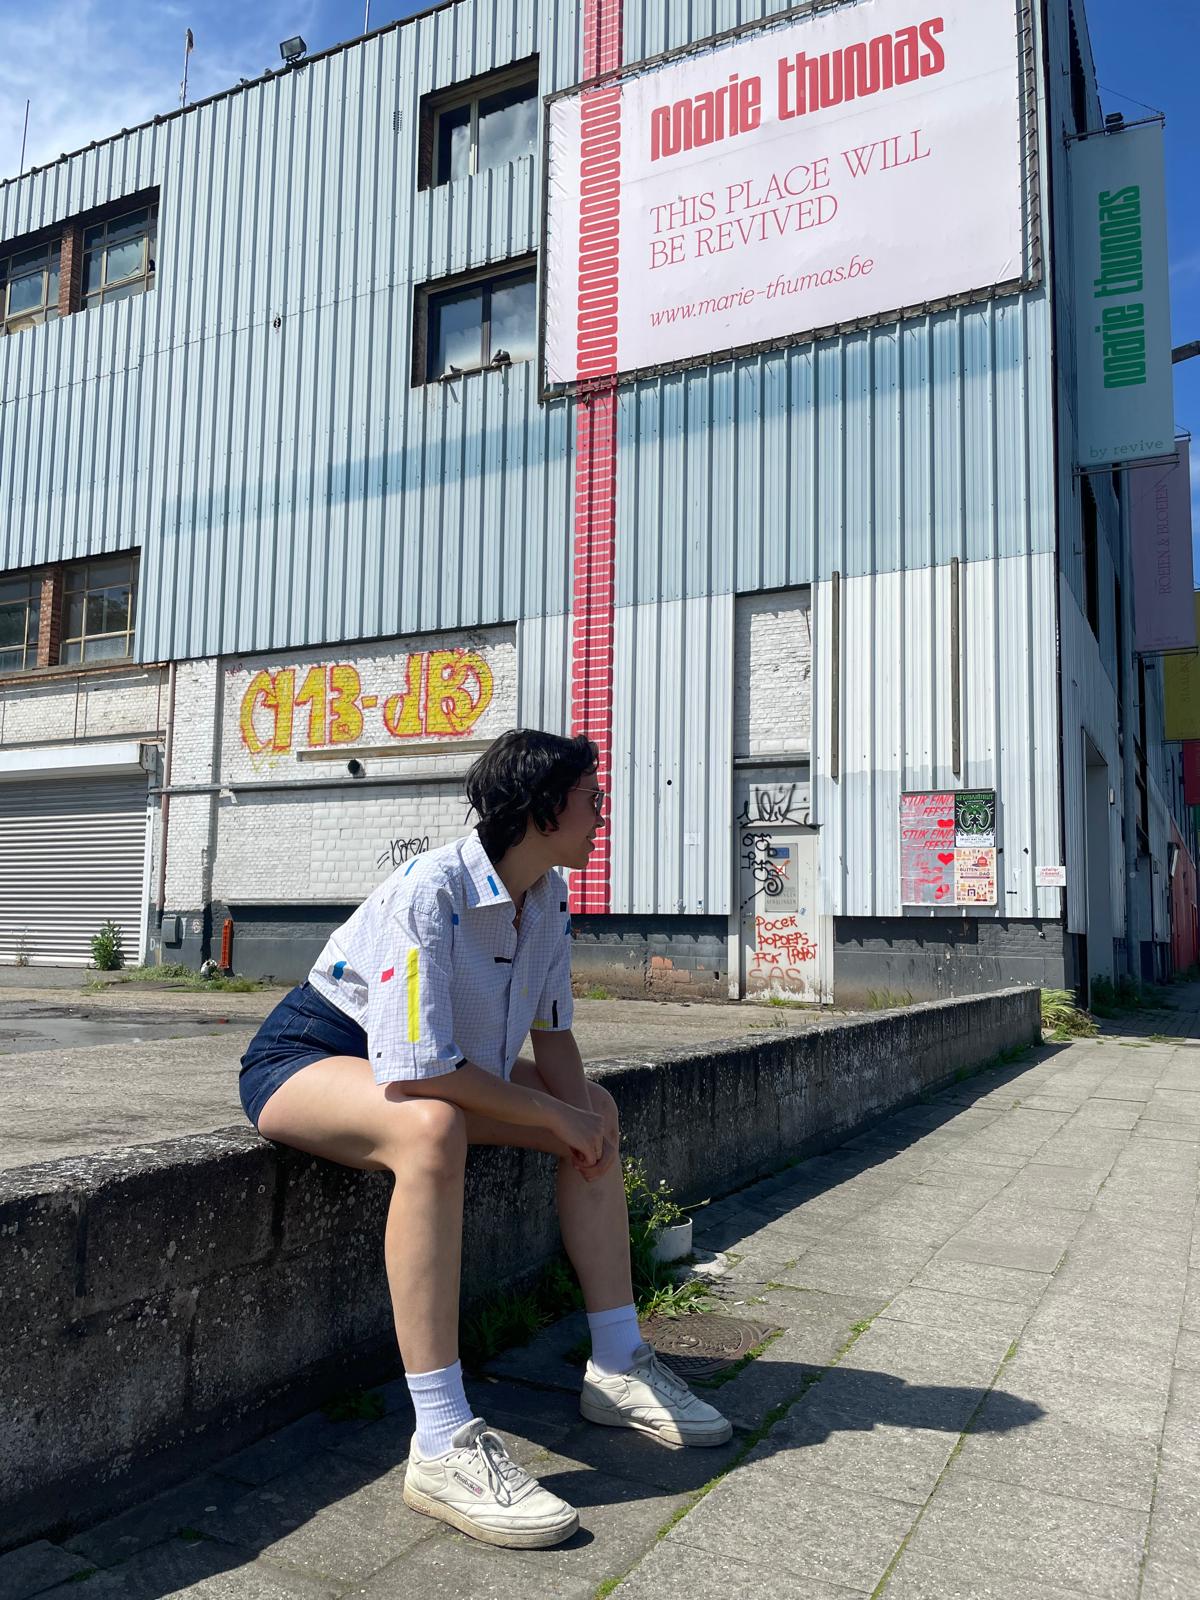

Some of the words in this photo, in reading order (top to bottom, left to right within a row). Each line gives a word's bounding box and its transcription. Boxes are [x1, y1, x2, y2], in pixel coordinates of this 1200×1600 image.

[651, 73, 761, 162] marie
[778, 17, 946, 121] thumas
[649, 191, 717, 235] THIS
[725, 158, 831, 215] PLACE
[841, 129, 932, 180] WILL
[649, 235, 686, 270] BE
[695, 195, 839, 259] REVIVED
[1094, 184, 1143, 299] thumas
[649, 256, 875, 329] www.marie-thumas.be
[1094, 303, 1147, 390] marie
[1090, 445, 1107, 460] by
[1113, 440, 1164, 456] revive
